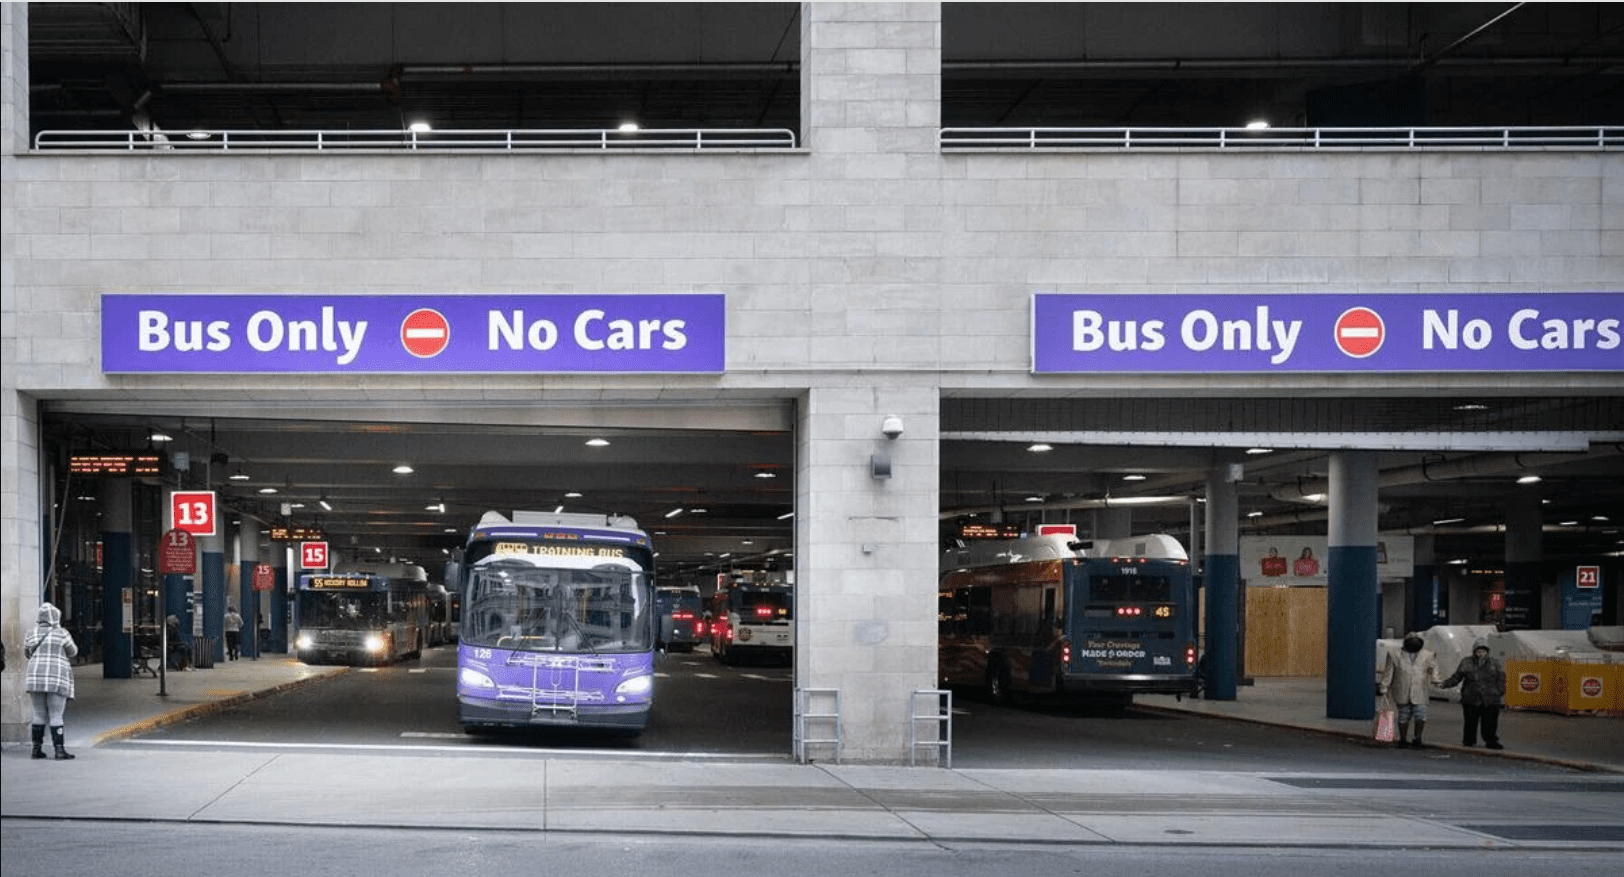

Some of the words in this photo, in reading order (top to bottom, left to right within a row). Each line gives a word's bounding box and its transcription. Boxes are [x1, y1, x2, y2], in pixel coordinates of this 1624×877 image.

[138, 310, 231, 351] Bus
[246, 306, 368, 365] Only
[488, 310, 558, 350] No
[573, 309, 687, 350] Cars
[1073, 310, 1165, 351] Bus
[1180, 305, 1303, 364] Only
[1423, 310, 1492, 350] No
[1508, 308, 1621, 350] Cars
[178, 502, 209, 525] 13
[169, 532, 188, 546] 13
[305, 548, 324, 562] 15
[533, 545, 594, 556] TRAINING
[598, 548, 623, 558] BUS
[258, 565, 270, 575] 15
[1580, 571, 1596, 583] 21
[1155, 606, 1170, 617] 45
[1082, 649, 1107, 658] MADE
[1116, 649, 1146, 658] ORDER
